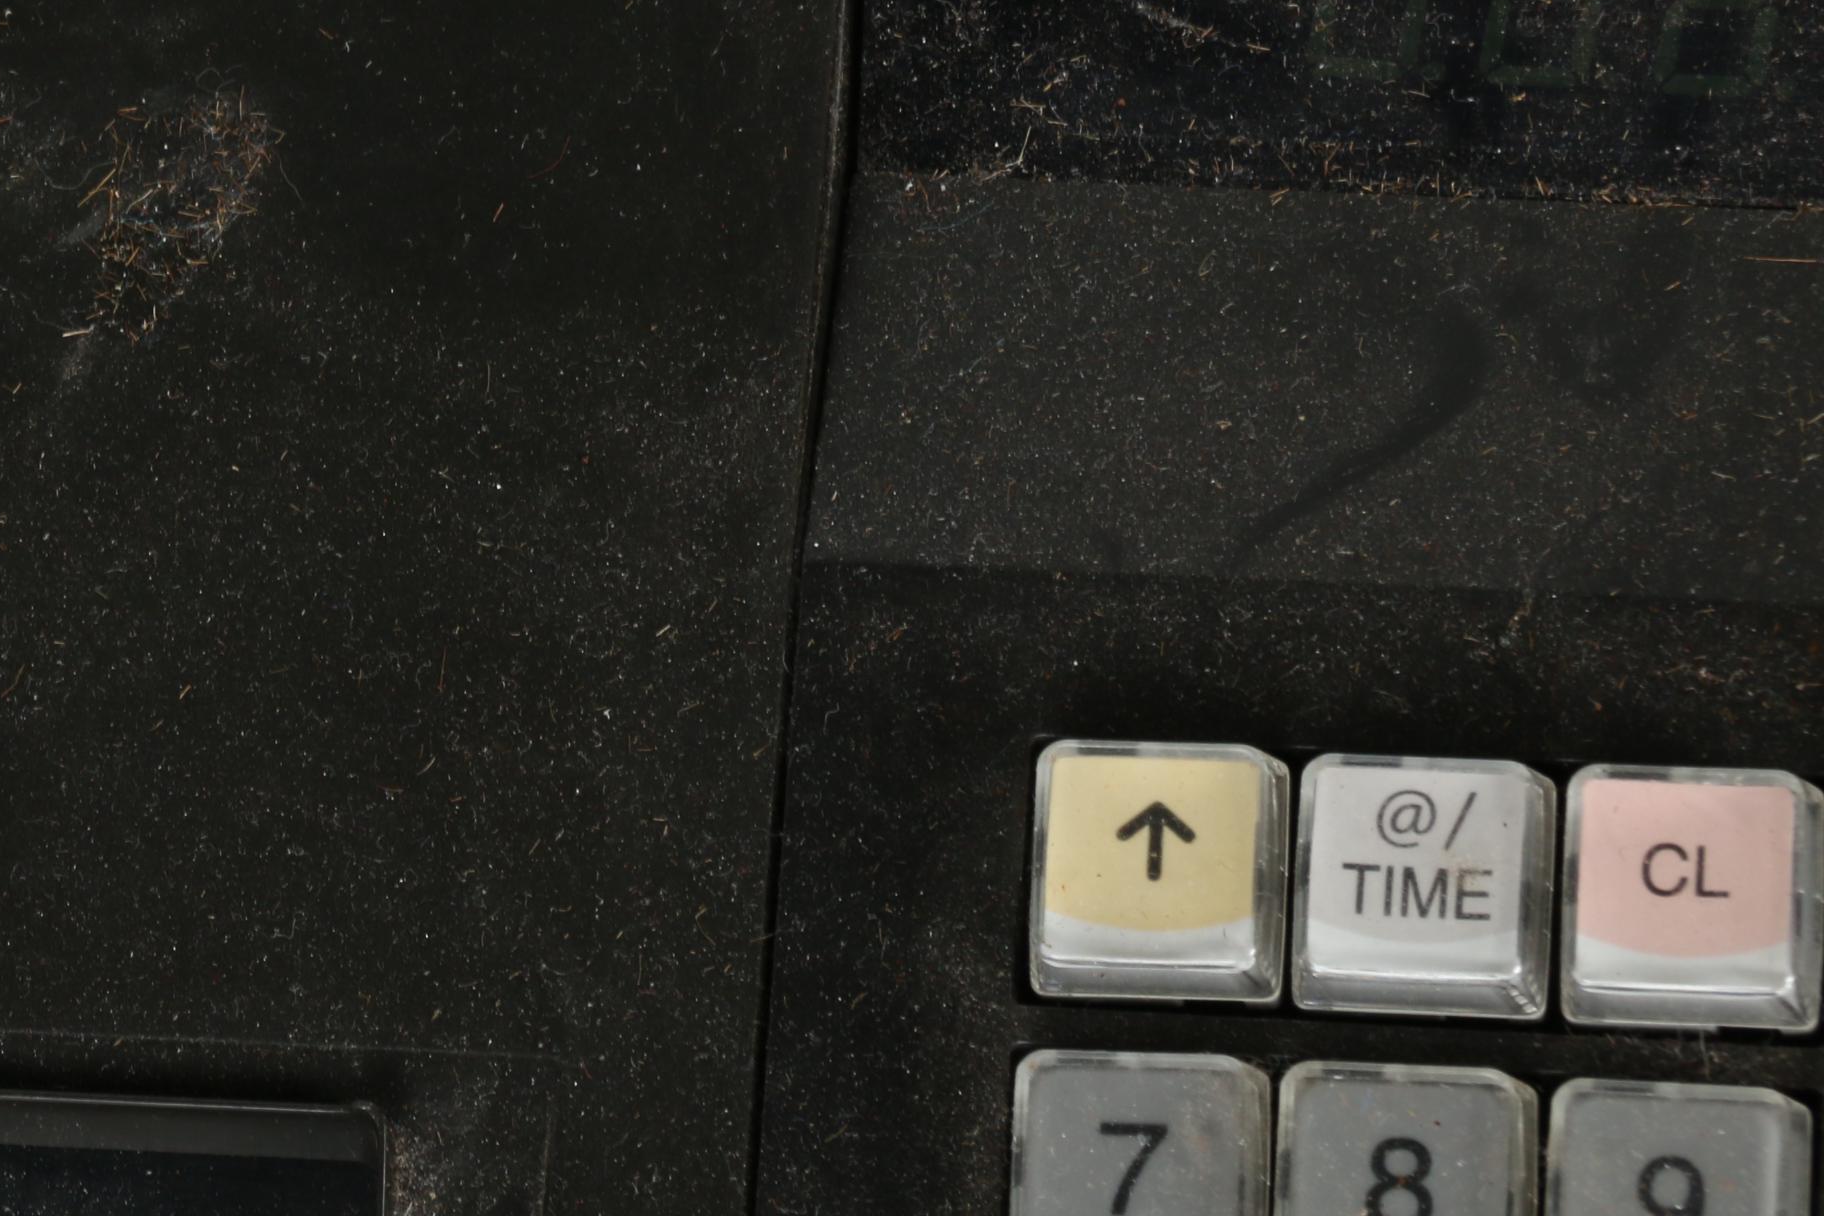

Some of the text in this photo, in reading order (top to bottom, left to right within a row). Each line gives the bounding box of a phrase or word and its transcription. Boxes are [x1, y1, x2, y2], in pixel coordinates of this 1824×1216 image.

[1376, 789, 1477, 850] @/
[1341, 862, 1494, 921] TIME
[1640, 841, 1730, 899] CL
[1099, 1121, 1169, 1216] 7
[1365, 1136, 1434, 1216] 8
[1637, 1154, 1706, 1216] 9
